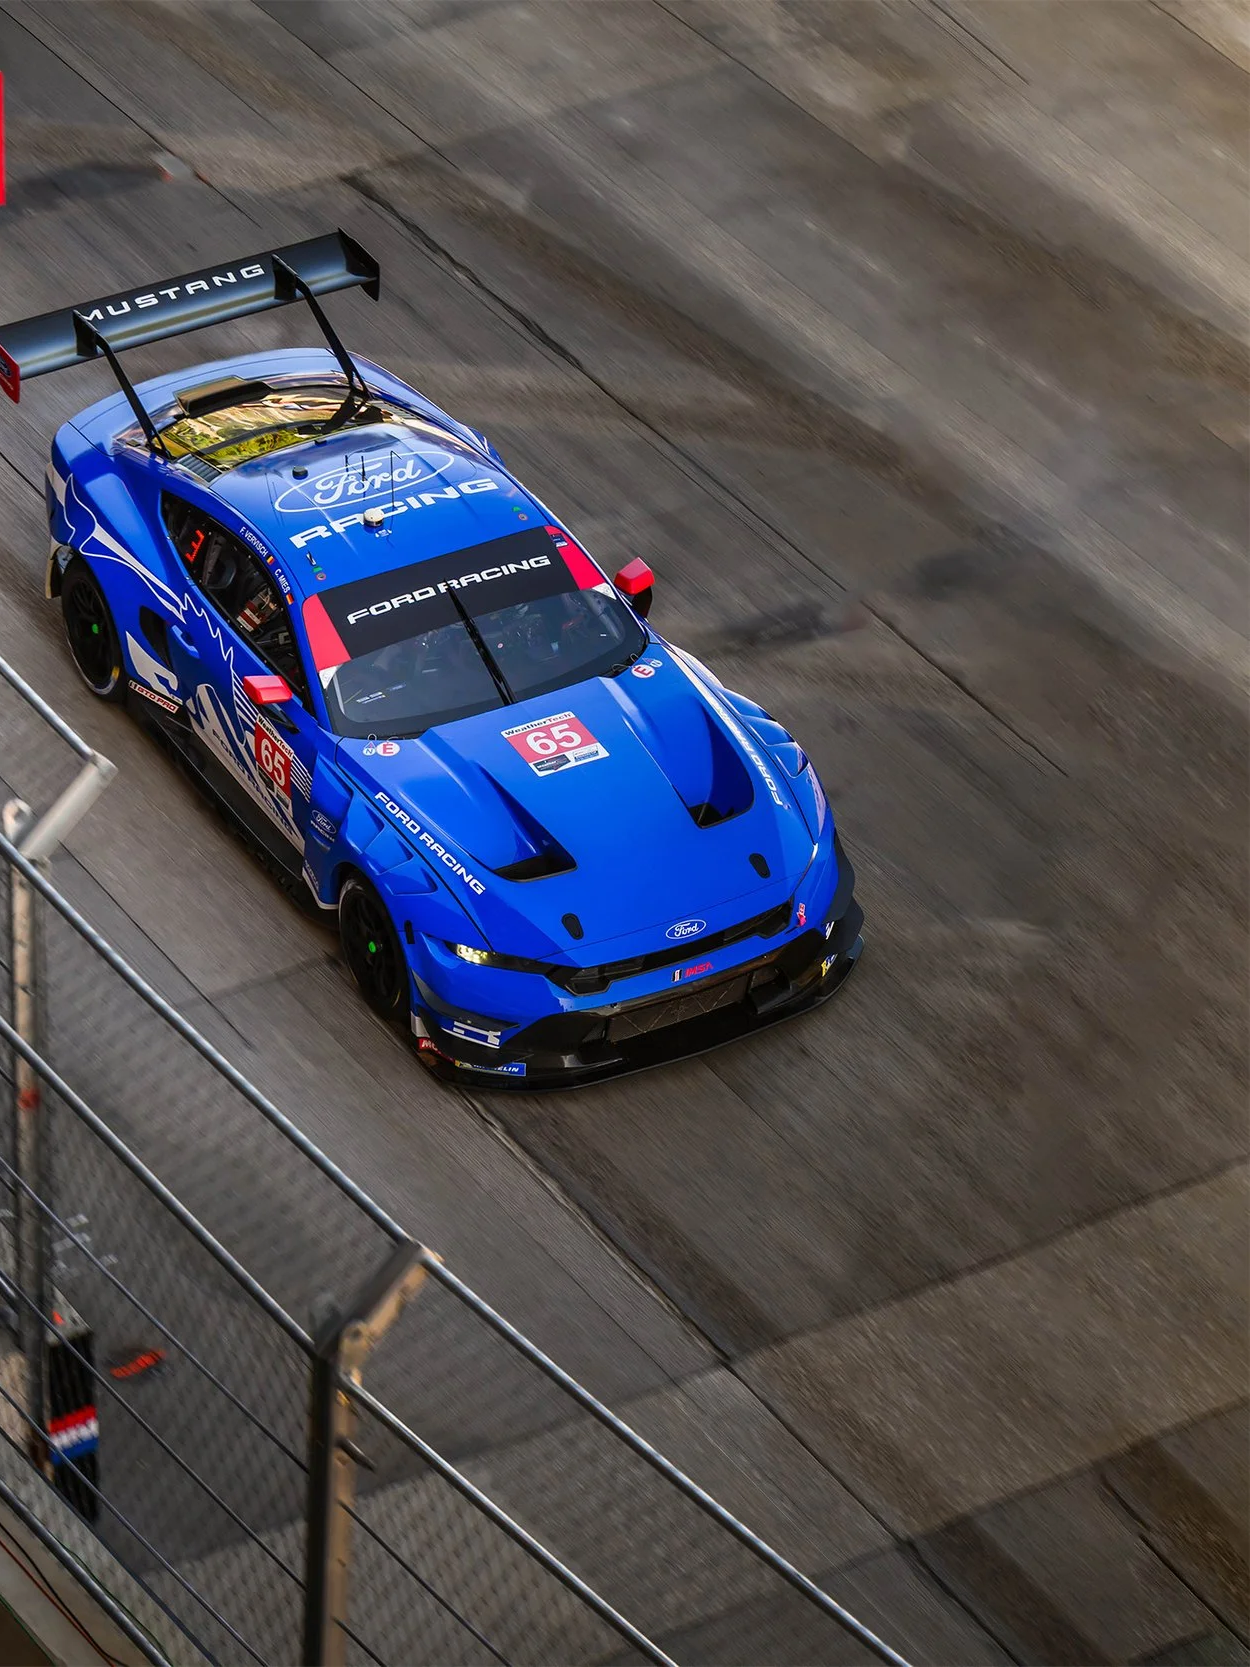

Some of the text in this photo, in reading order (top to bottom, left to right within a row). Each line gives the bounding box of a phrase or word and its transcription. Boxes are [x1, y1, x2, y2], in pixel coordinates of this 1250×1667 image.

[81, 263, 266, 322] MUSTANG
[313, 459, 422, 505] Ford
[288, 478, 499, 549] RACING
[244, 530, 269, 557] VERVISCH
[277, 574, 291, 594] MIES
[346, 555, 551, 625] FORD RACING
[156, 697, 176, 711] PRO
[504, 713, 572, 736] WeatherTech
[258, 716, 293, 758] WeatherTech
[526, 723, 582, 755] 65
[261, 738, 286, 787] 65
[751, 753, 784, 807] FORD
[374, 791, 486, 895] FORD RACING
[684, 961, 714, 978] IMSA
